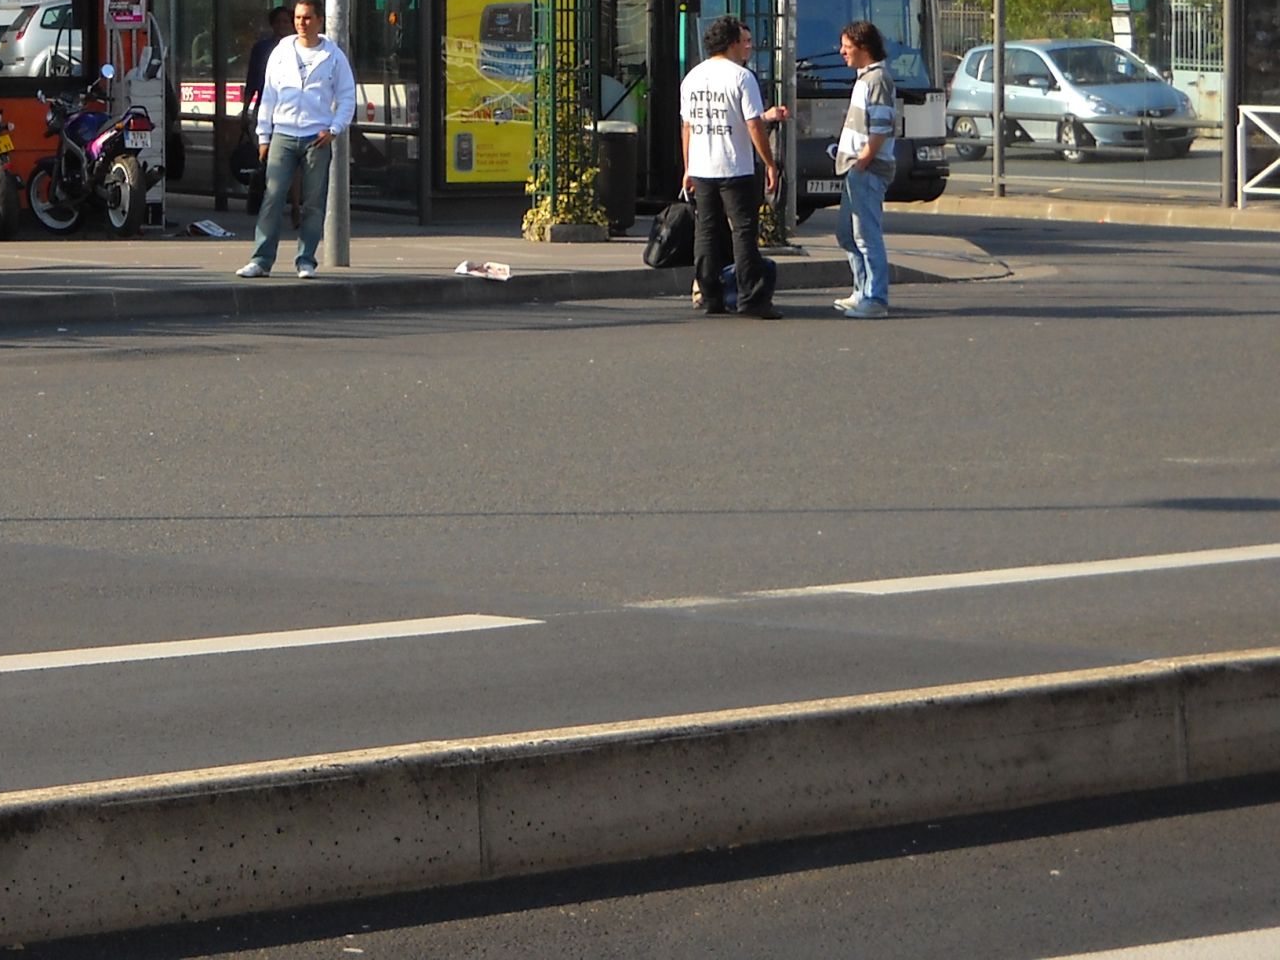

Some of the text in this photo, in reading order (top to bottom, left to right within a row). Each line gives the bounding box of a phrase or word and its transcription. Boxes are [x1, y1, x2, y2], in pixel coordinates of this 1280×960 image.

[181, 87, 194, 101] 195
[690, 90, 725, 103] ATOM
[810, 182, 824, 190] 771
